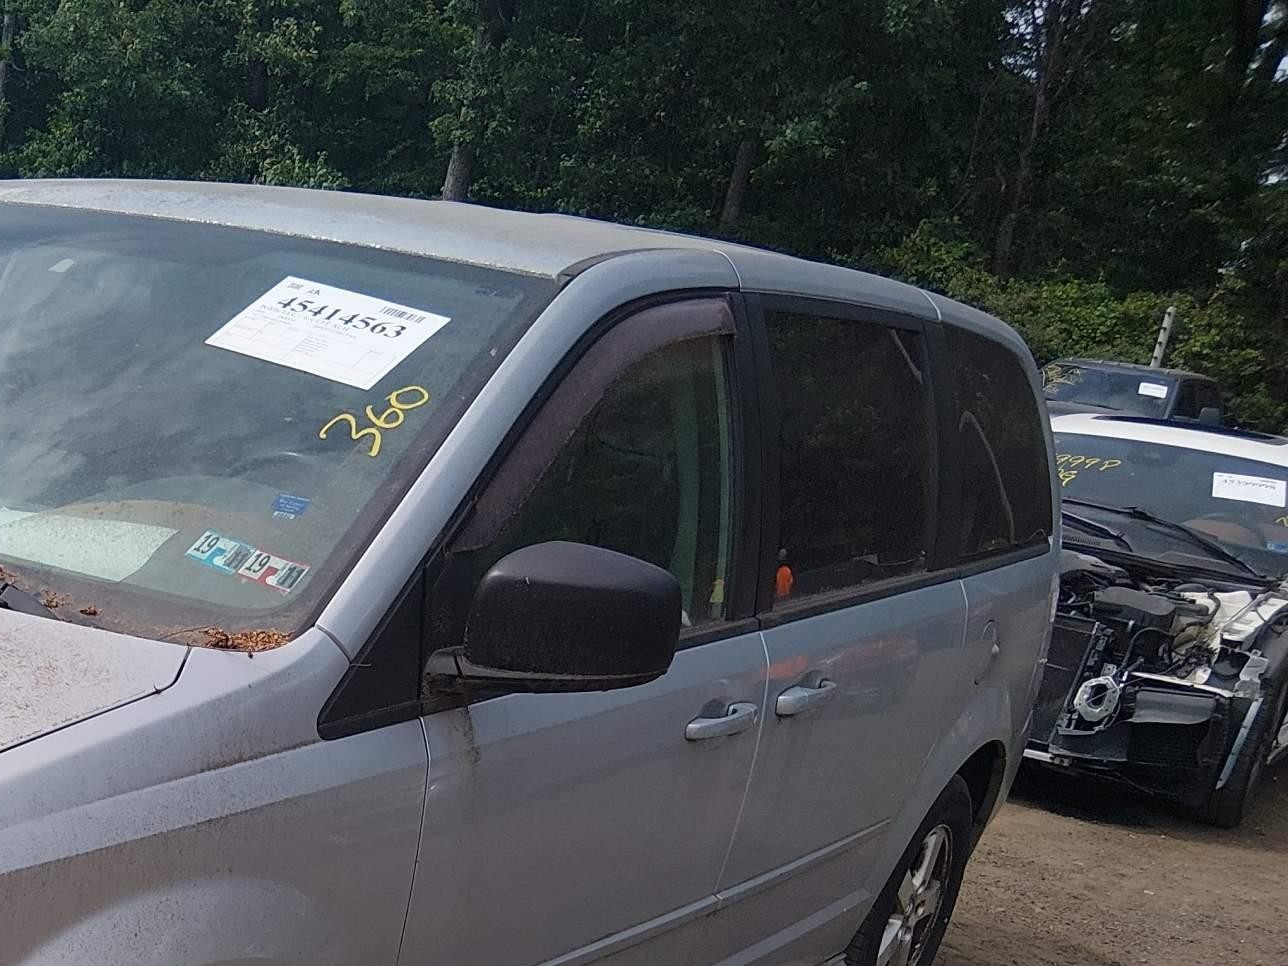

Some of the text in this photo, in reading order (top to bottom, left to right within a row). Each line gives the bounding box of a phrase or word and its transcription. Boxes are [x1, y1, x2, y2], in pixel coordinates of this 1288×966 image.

[277, 297, 407, 338] 45414563
[319, 386, 431, 457] 360
[193, 534, 219, 553] 19
[245, 554, 270, 573] 19
